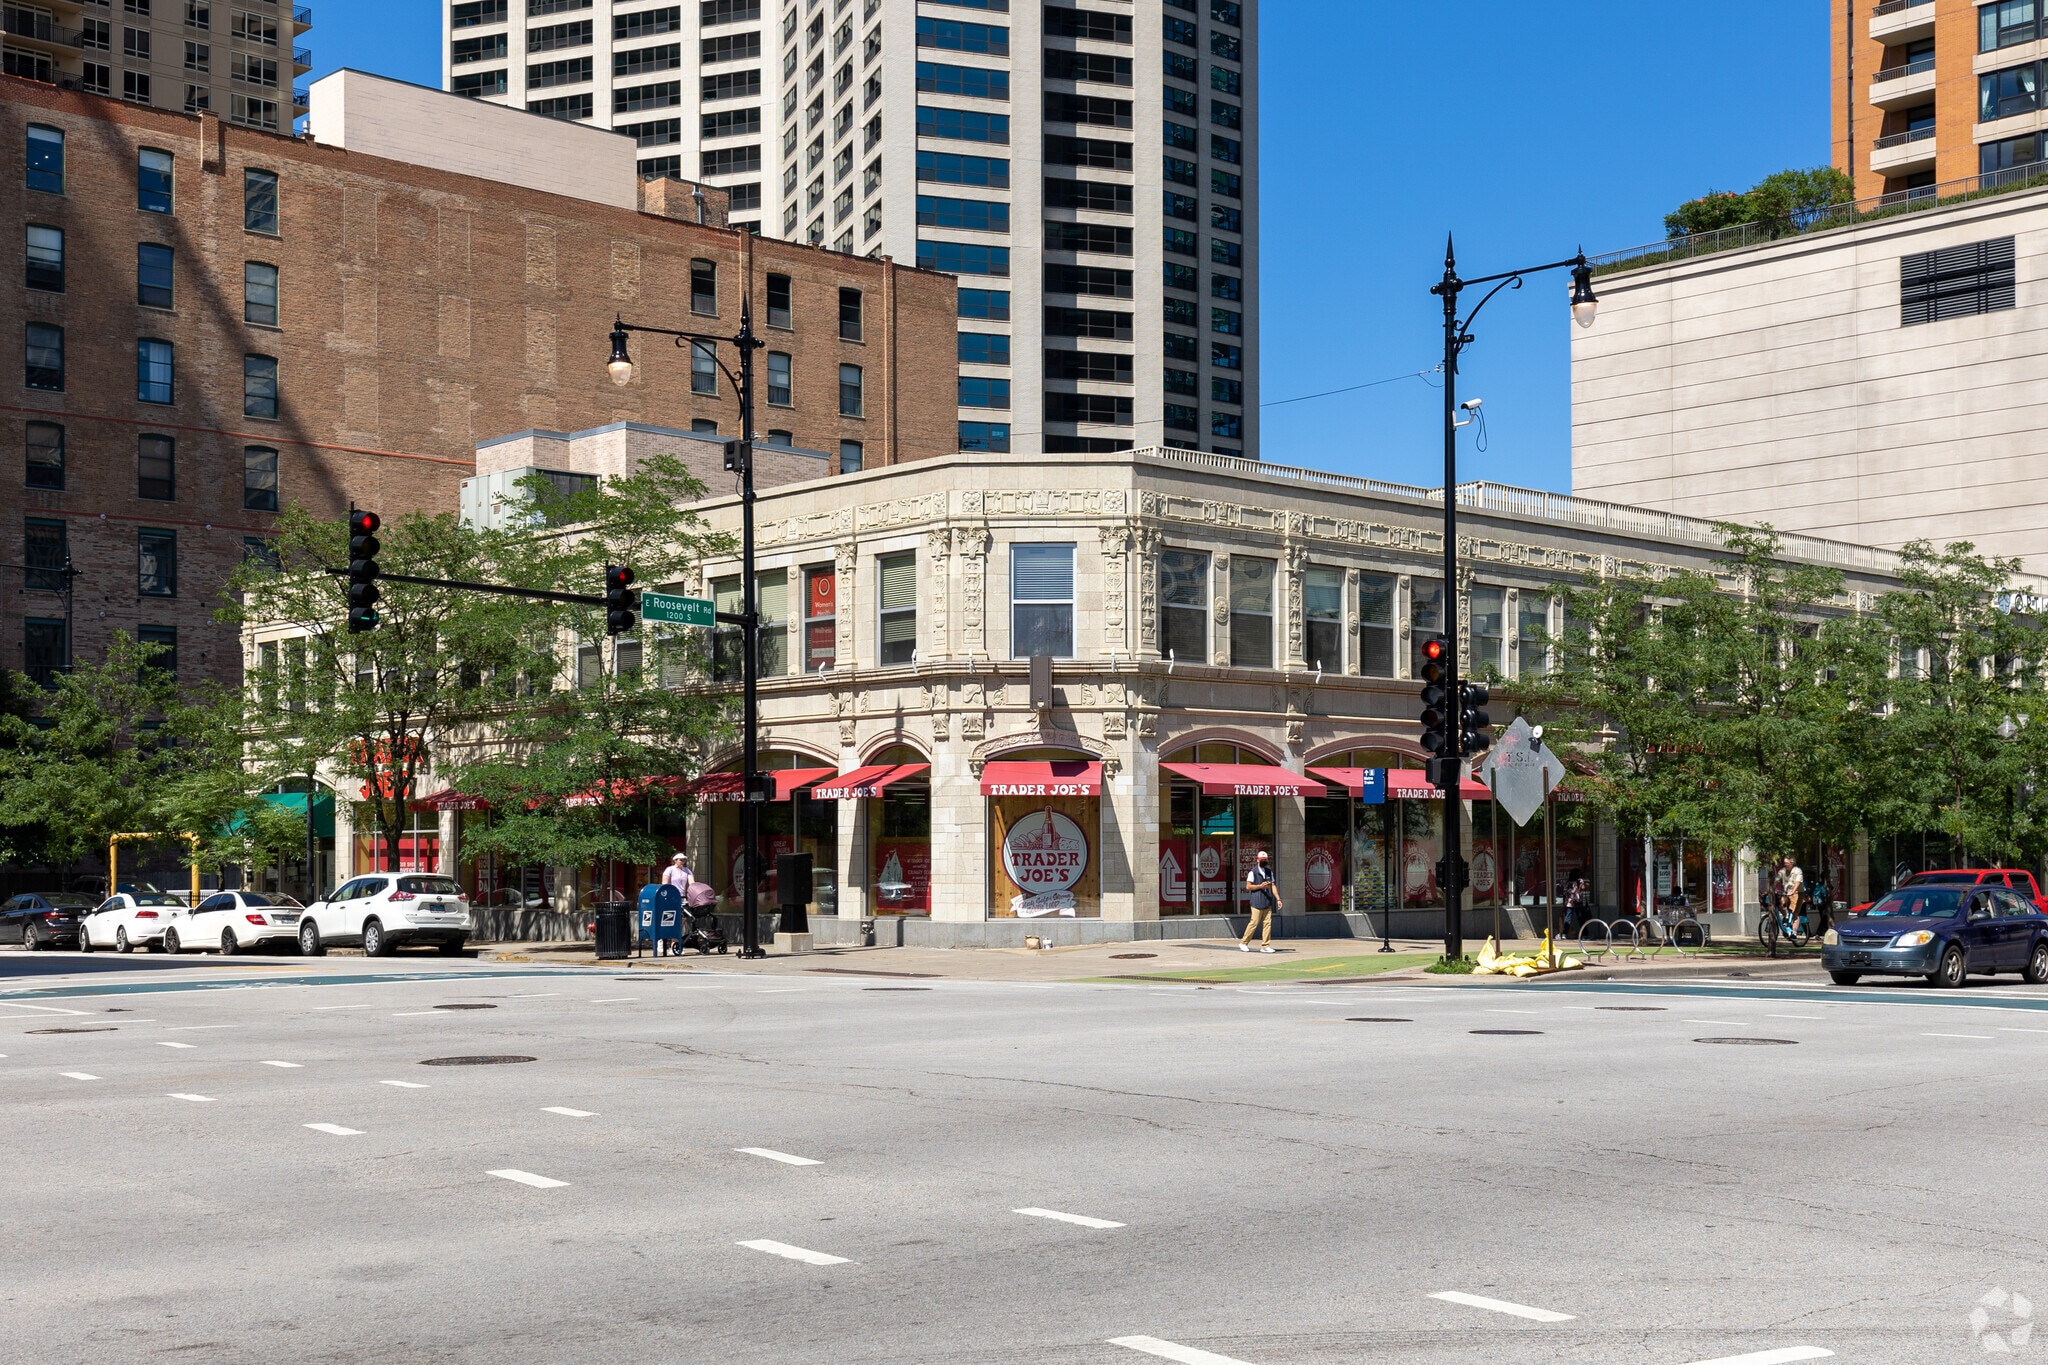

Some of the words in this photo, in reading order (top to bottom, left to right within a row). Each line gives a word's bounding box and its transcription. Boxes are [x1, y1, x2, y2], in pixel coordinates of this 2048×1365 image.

[645, 599, 650, 607] E
[653, 597, 700, 613] Roosevelt
[703, 606, 712, 615] Rd
[666, 611, 684, 620] 1200
[686, 613, 692, 621] S
[816, 788, 849, 799] TRADER
[851, 786, 877, 798] JOE'S
[990, 784, 1046, 796] TRADER
[1049, 783, 1091, 796] JOE'S
[1234, 784, 1271, 796] TRADER
[1273, 785, 1299, 796] JOE'S
[1397, 788, 1429, 799] TRADER
[1557, 792, 1585, 802] TRADER
[437, 802, 459, 811] TRADER
[460, 800, 476, 810] JOE'S
[1011, 852, 1080, 867] TRADER
[1019, 867, 1071, 883] JOE'S
